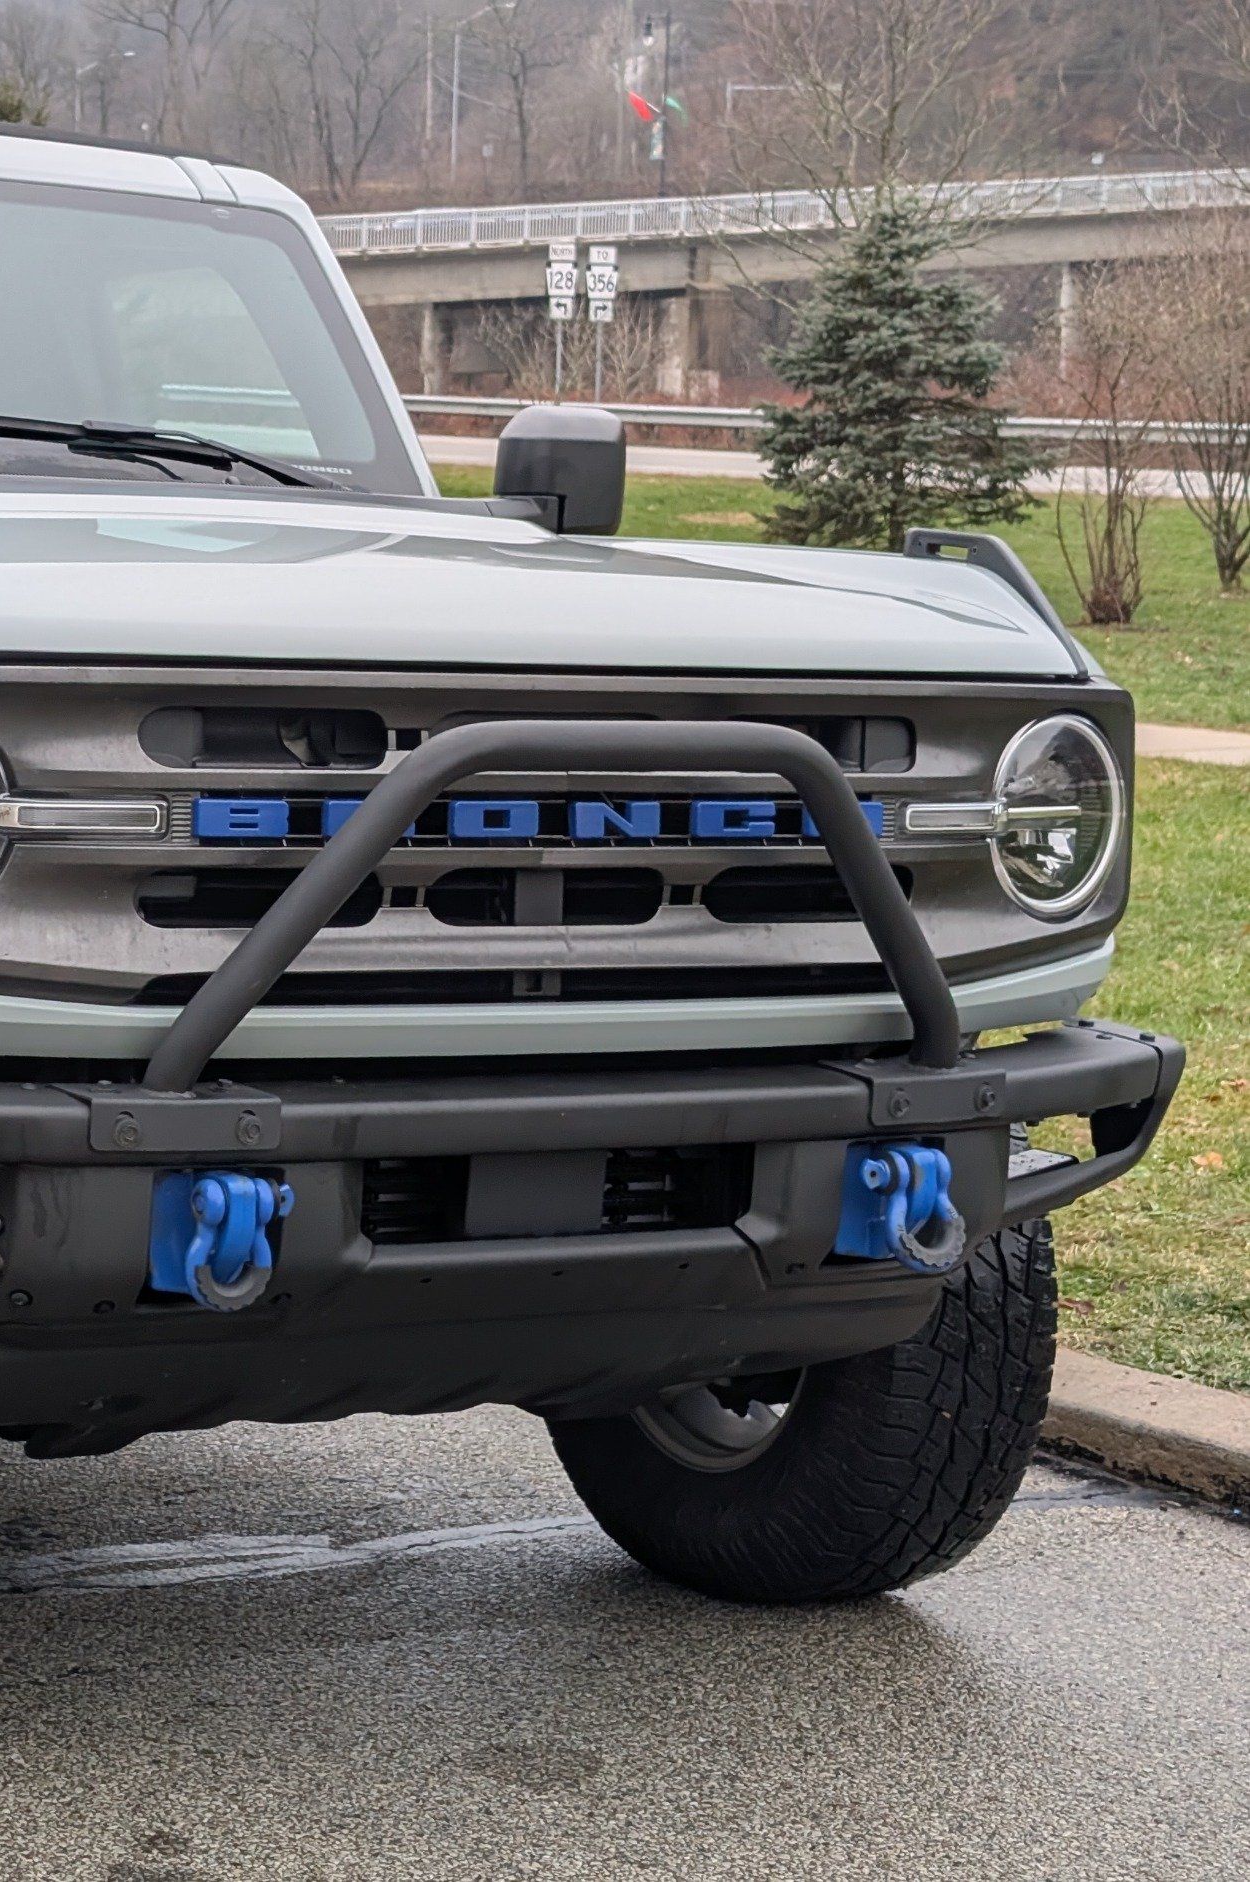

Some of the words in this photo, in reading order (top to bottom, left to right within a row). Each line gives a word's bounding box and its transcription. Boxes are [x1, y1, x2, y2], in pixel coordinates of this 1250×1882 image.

[551, 245, 573, 257] NORTH
[597, 250, 608, 260] TO
[549, 271, 574, 289] 128
[588, 273, 615, 292] 356
